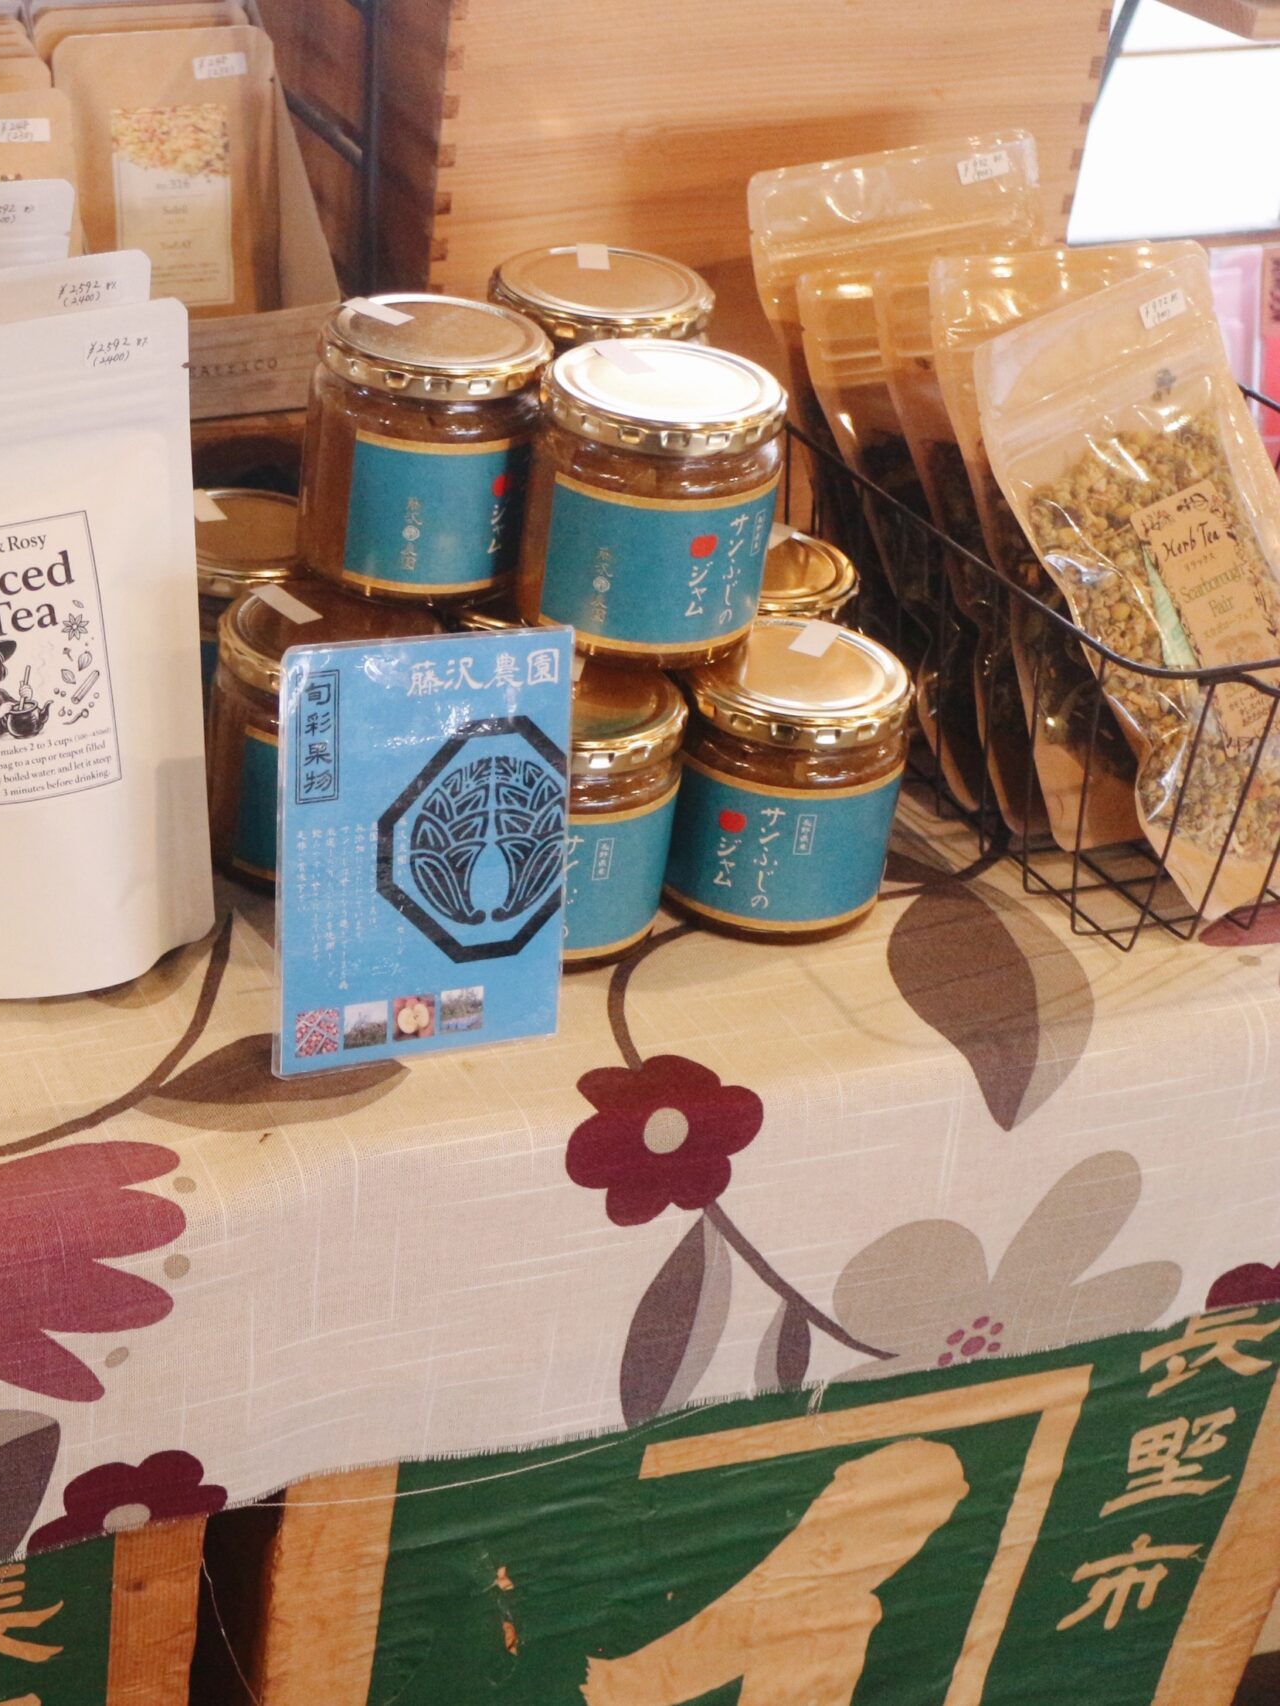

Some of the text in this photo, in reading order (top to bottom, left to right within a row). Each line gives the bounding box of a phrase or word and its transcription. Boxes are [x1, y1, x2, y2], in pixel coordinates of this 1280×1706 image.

[684, 565, 709, 618] ジャム
[719, 514, 749, 626] サンふじの
[1208, 594, 1235, 618] Fair
[406, 648, 560, 698] 藤沢農園
[0, 744, 28, 756] makes
[29, 743, 35, 751] 2
[36, 742, 46, 750] to
[53, 737, 73, 749] cups
[14, 759, 24, 768] to
[31, 757, 48, 768] cup
[47, 754, 58, 762] or
[58, 748, 84, 762] teapot
[85, 740, 106, 755] filled
[303, 681, 333, 794] 旬彩果物
[3, 771, 31, 783] boiled
[57, 764, 73, 774] and
[73, 760, 85, 770] let
[85, 758, 93, 768] it
[93, 755, 113, 768] steep
[10, 784, 46, 797] minutes
[46, 778, 73, 790] before
[712, 838, 742, 888] ジャム
[751, 807, 786, 909] サンふじの
